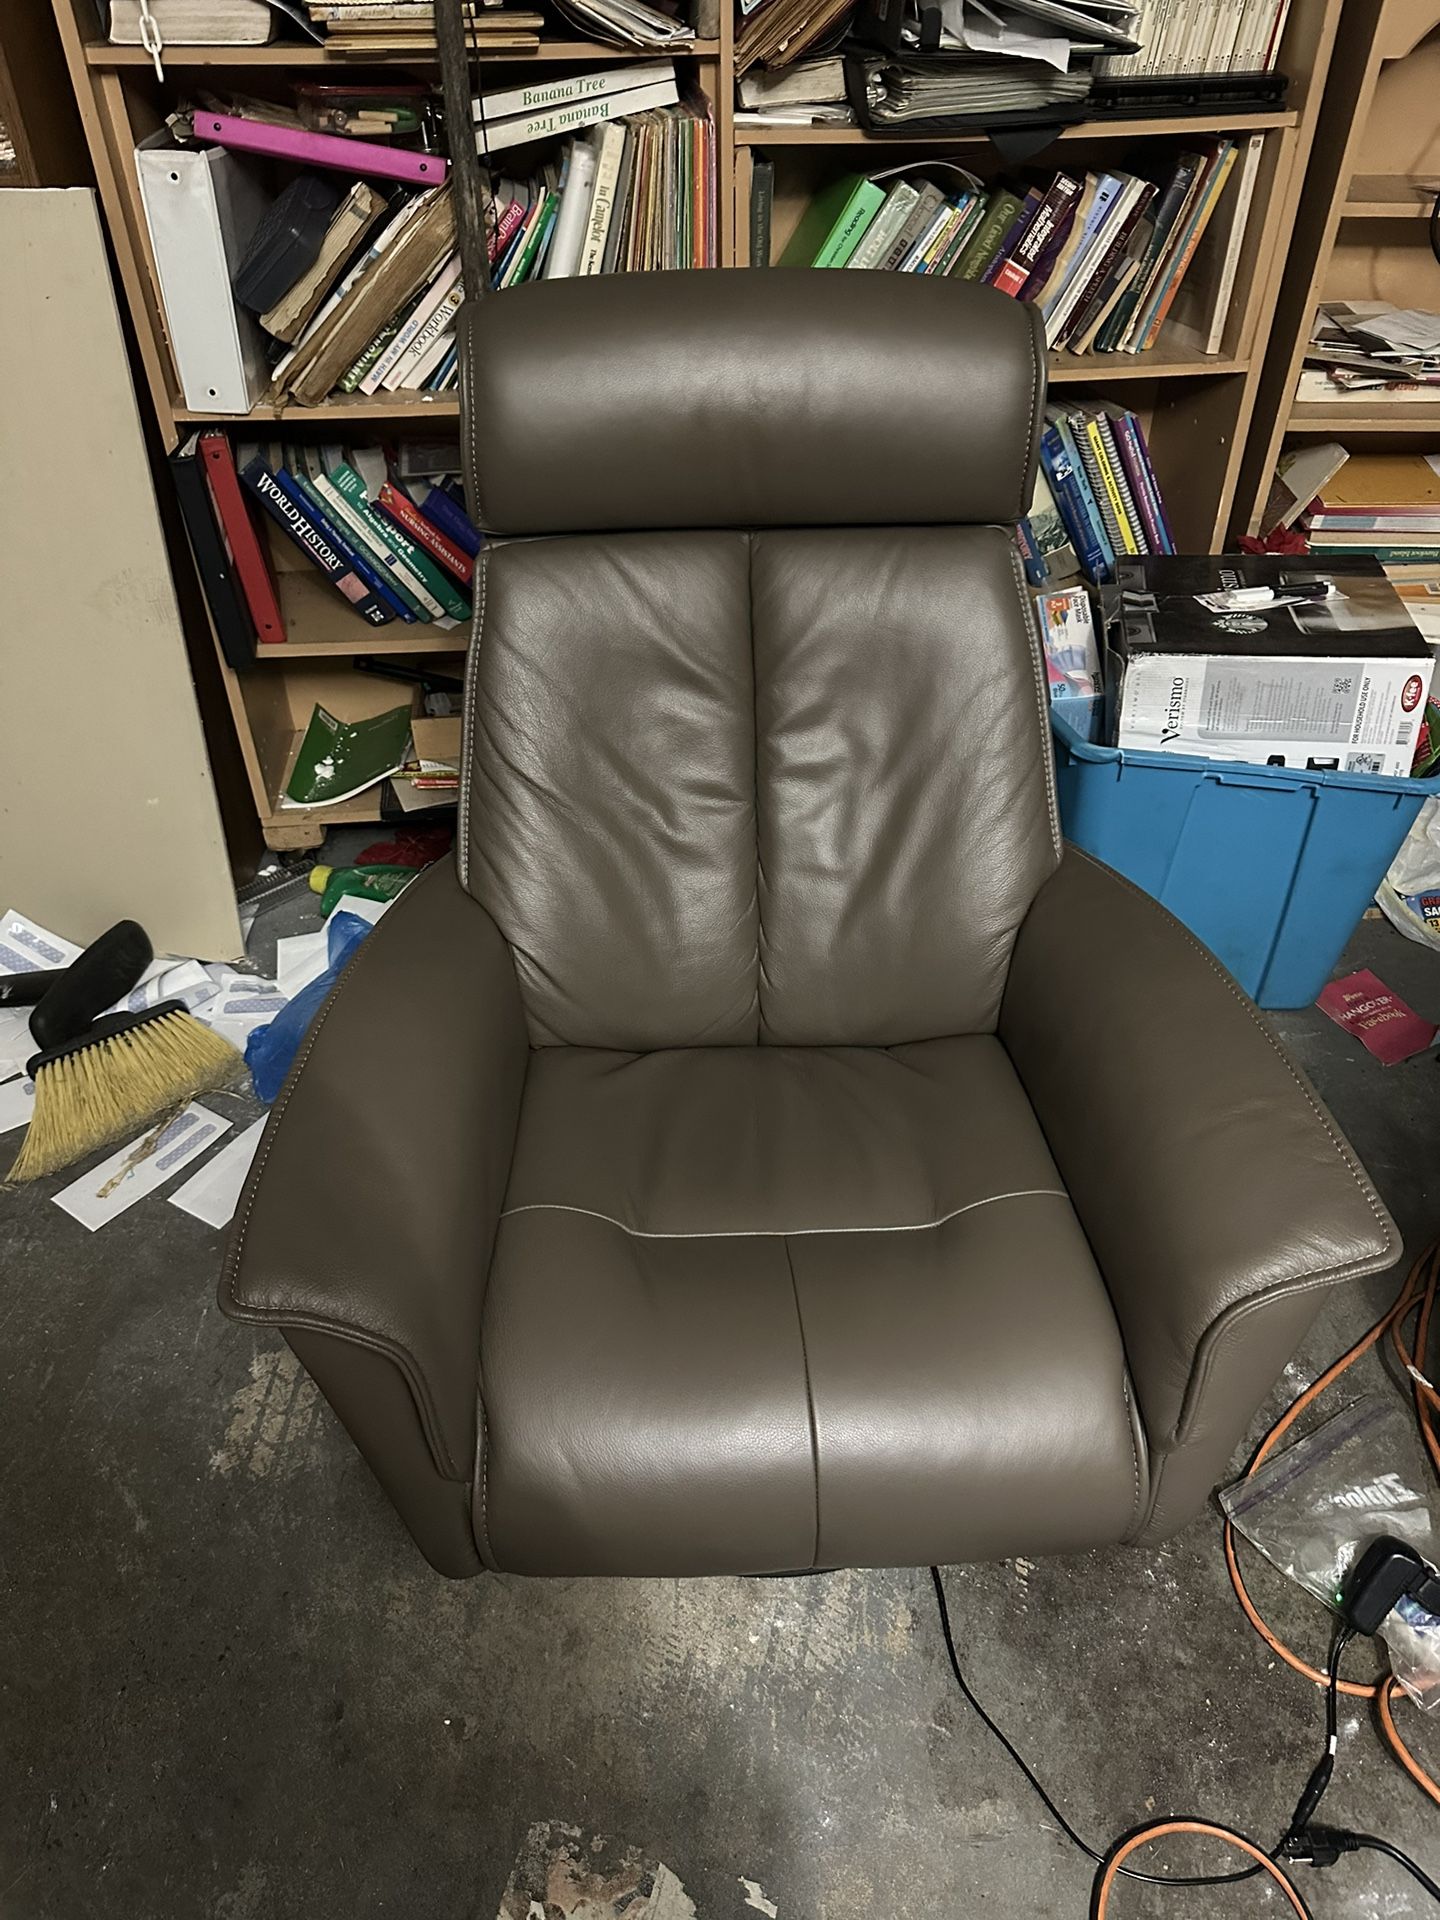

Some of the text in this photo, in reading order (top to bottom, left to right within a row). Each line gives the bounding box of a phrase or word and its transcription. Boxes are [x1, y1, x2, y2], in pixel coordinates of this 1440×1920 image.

[522, 77, 606, 106] Banana Tree
[527, 102, 610, 133] Banana Tree
[598, 184, 610, 197] In
[586, 197, 611, 243] Camelot
[843, 206, 866, 236] Reading
[903, 191, 940, 240] Clerical
[995, 201, 1015, 225] Our
[1017, 203, 1054, 256] Mathematics
[981, 222, 1003, 250] Good
[1024, 218, 1055, 262] Integrated
[1101, 230, 1128, 268] BUILDING
[1081, 273, 1102, 302] SPEECH
[369, 362, 387, 382] MATH
[382, 353, 393, 364] IN
[389, 342, 402, 356] MY
[397, 318, 420, 345] WORLD
[407, 302, 453, 360] Workbook
[1123, 430, 1131, 441] GO
[253, 472, 301, 525] WORLD
[289, 515, 344, 575] HISTORY
[300, 480, 326, 507] Exploring
[324, 506, 336, 518] the
[334, 517, 352, 536] World
[350, 535, 359, 544] of
[357, 542, 399, 588] OCEANOGRAPHY
[356, 489, 417, 557] Psport
[356, 500, 365, 509] to
[361, 506, 390, 539] Algebra
[386, 536, 399, 549] and
[395, 547, 429, 585] Geometry
[398, 507, 432, 542] NURSING
[428, 535, 468, 576] ASSISTANTS
[1217, 569, 1239, 592] ismo
[1071, 594, 1083, 623] Face Mask
[1077, 594, 1091, 624] Disposable
[1161, 677, 1184, 743] Verismo
[1356, 701, 1366, 733] HOUSEHOLD
[1363, 677, 1371, 690] ONLY
